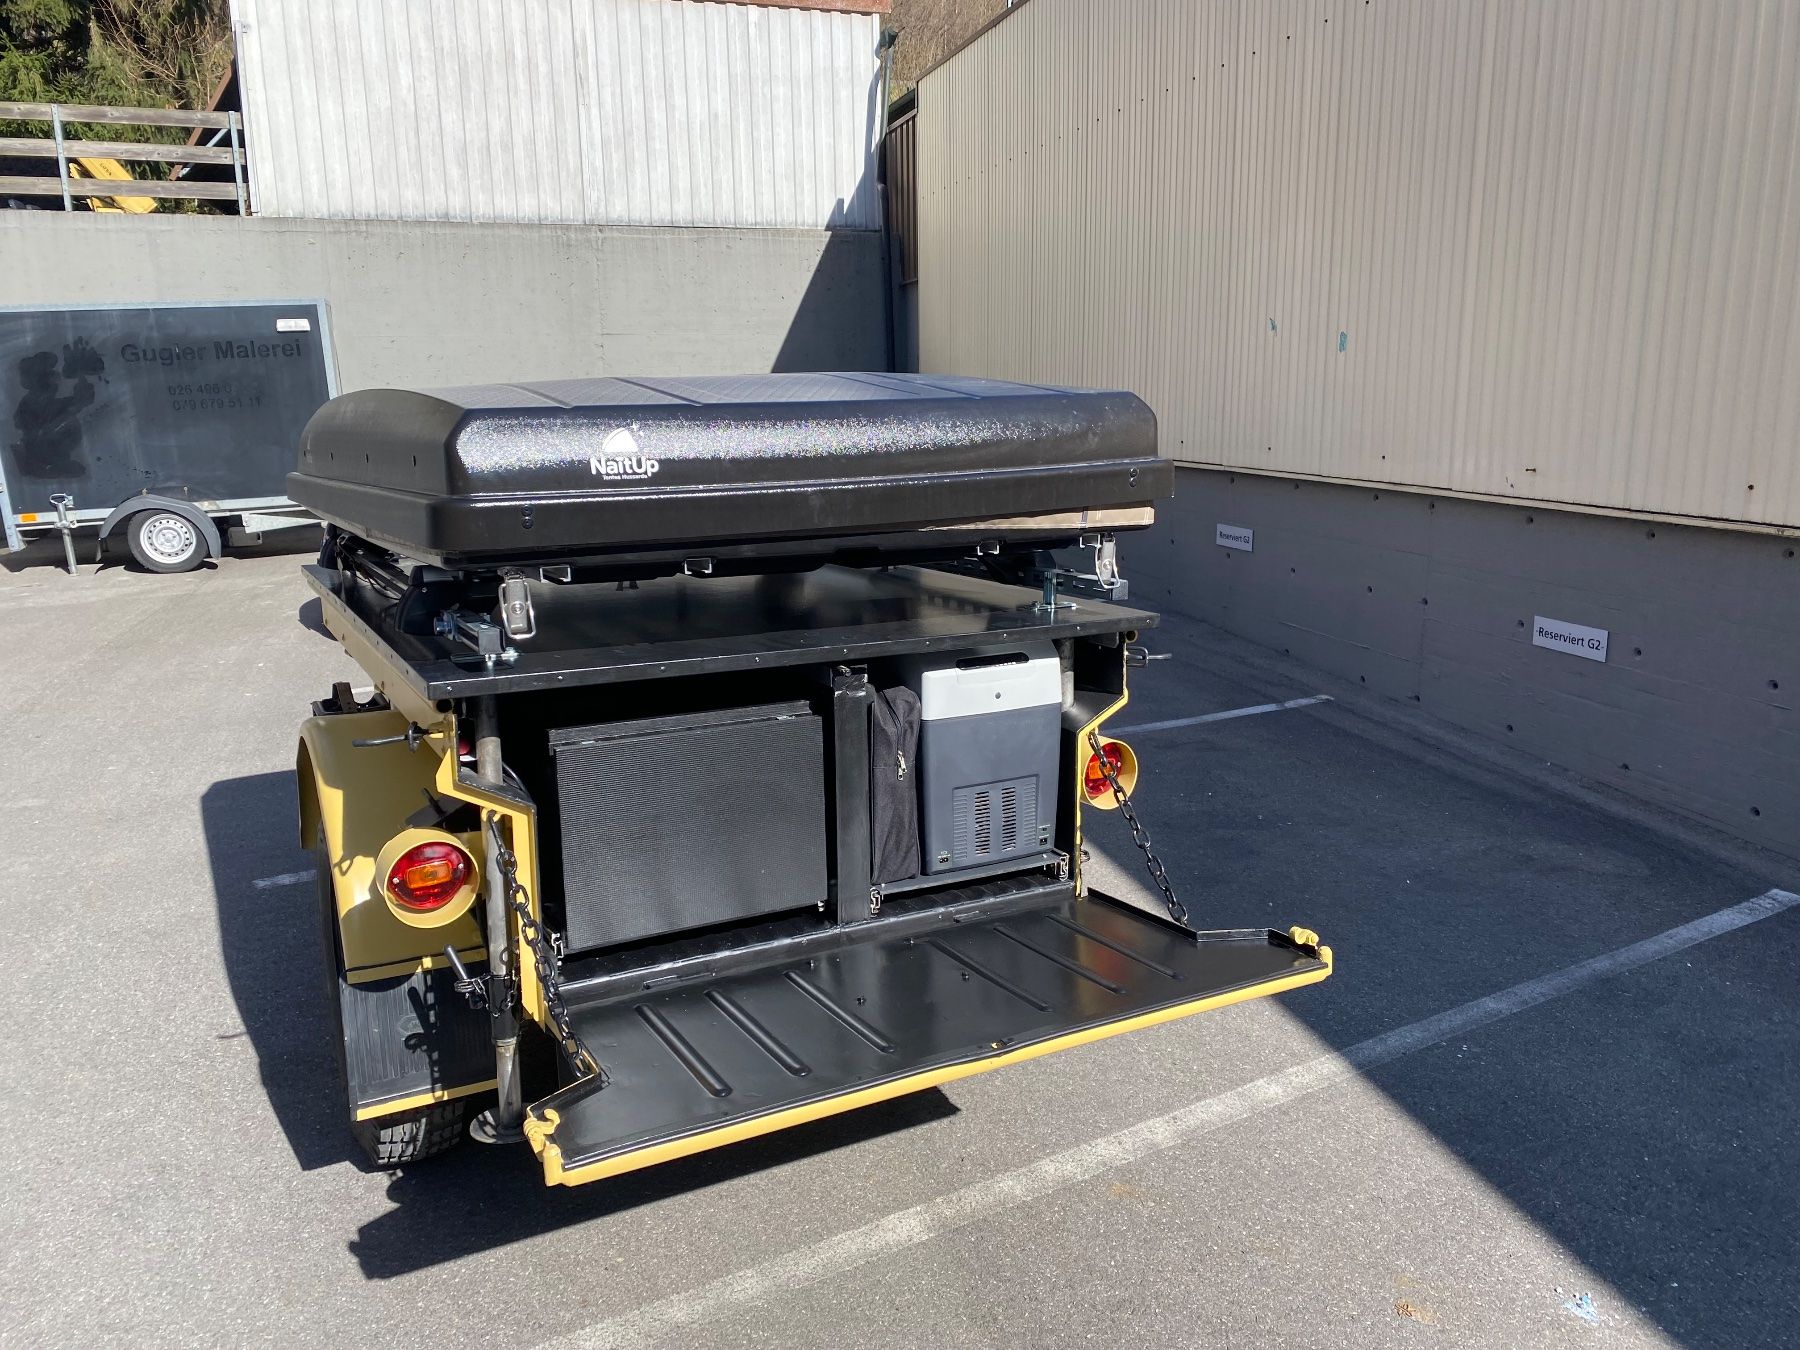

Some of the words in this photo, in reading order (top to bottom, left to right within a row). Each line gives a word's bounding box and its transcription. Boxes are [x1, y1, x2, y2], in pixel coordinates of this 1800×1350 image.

[120, 343, 206, 367] Gugler
[213, 338, 302, 360] Malerei
[1538, 627, 1585, 647] Reserviert
[1587, 639, 1601, 650] G2
